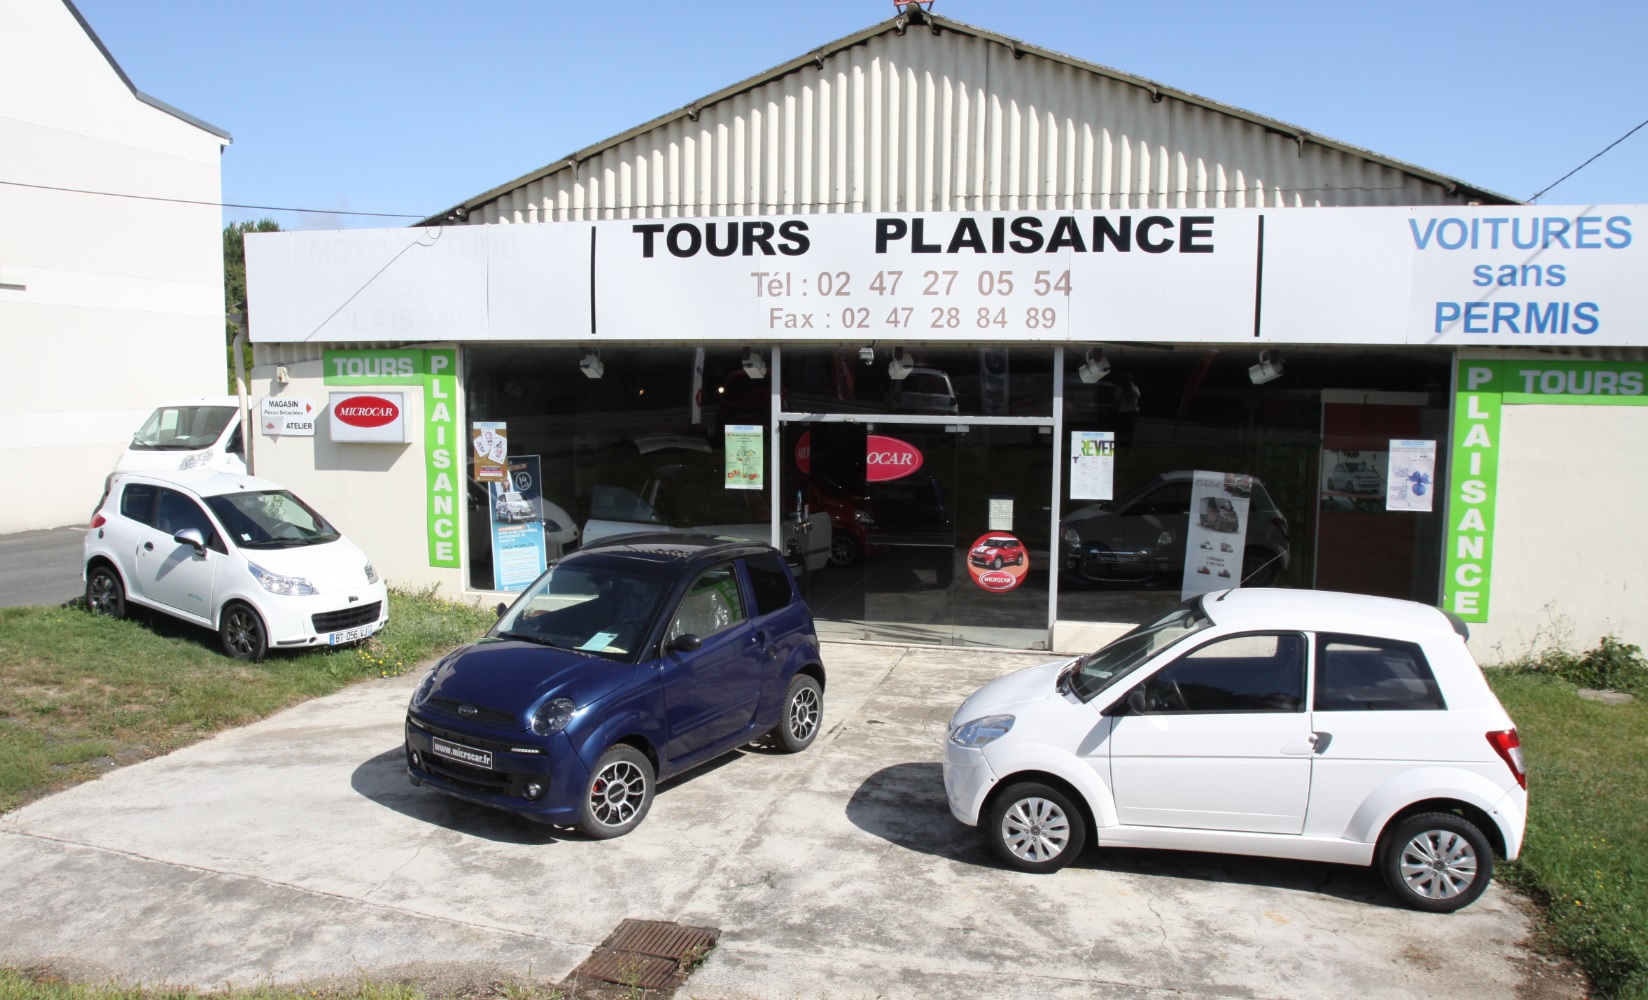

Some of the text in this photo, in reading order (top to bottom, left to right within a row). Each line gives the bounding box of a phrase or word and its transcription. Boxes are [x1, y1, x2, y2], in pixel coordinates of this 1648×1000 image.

[633, 216, 1214, 257] TOURS PLAISANCE
[1409, 216, 1633, 250] VOITURES
[817, 271, 851, 297] 02
[868, 270, 904, 297] 47
[922, 270, 959, 296] 27
[977, 270, 1014, 296] 05
[1033, 270, 1073, 296] 54
[1473, 263, 1567, 287] sans
[769, 307, 814, 329] Fax
[841, 307, 870, 329] 02
[885, 306, 914, 329] 47
[930, 307, 961, 329] 28
[976, 307, 1008, 329] 84
[1025, 307, 1056, 329] 89
[1434, 301, 1600, 334] PERMIS
[333, 357, 413, 377] TOURS
[1519, 370, 1644, 395] TOURS
[268, 400, 299, 408] MAGASIN
[339, 407, 393, 417] MICROCAR
[286, 422, 313, 430] ATELIER
[431, 355, 454, 561] PLAISANCE
[1454, 367, 1493, 615] PLAISANCE
[434, 744, 491, 765] www.microcar.fr
